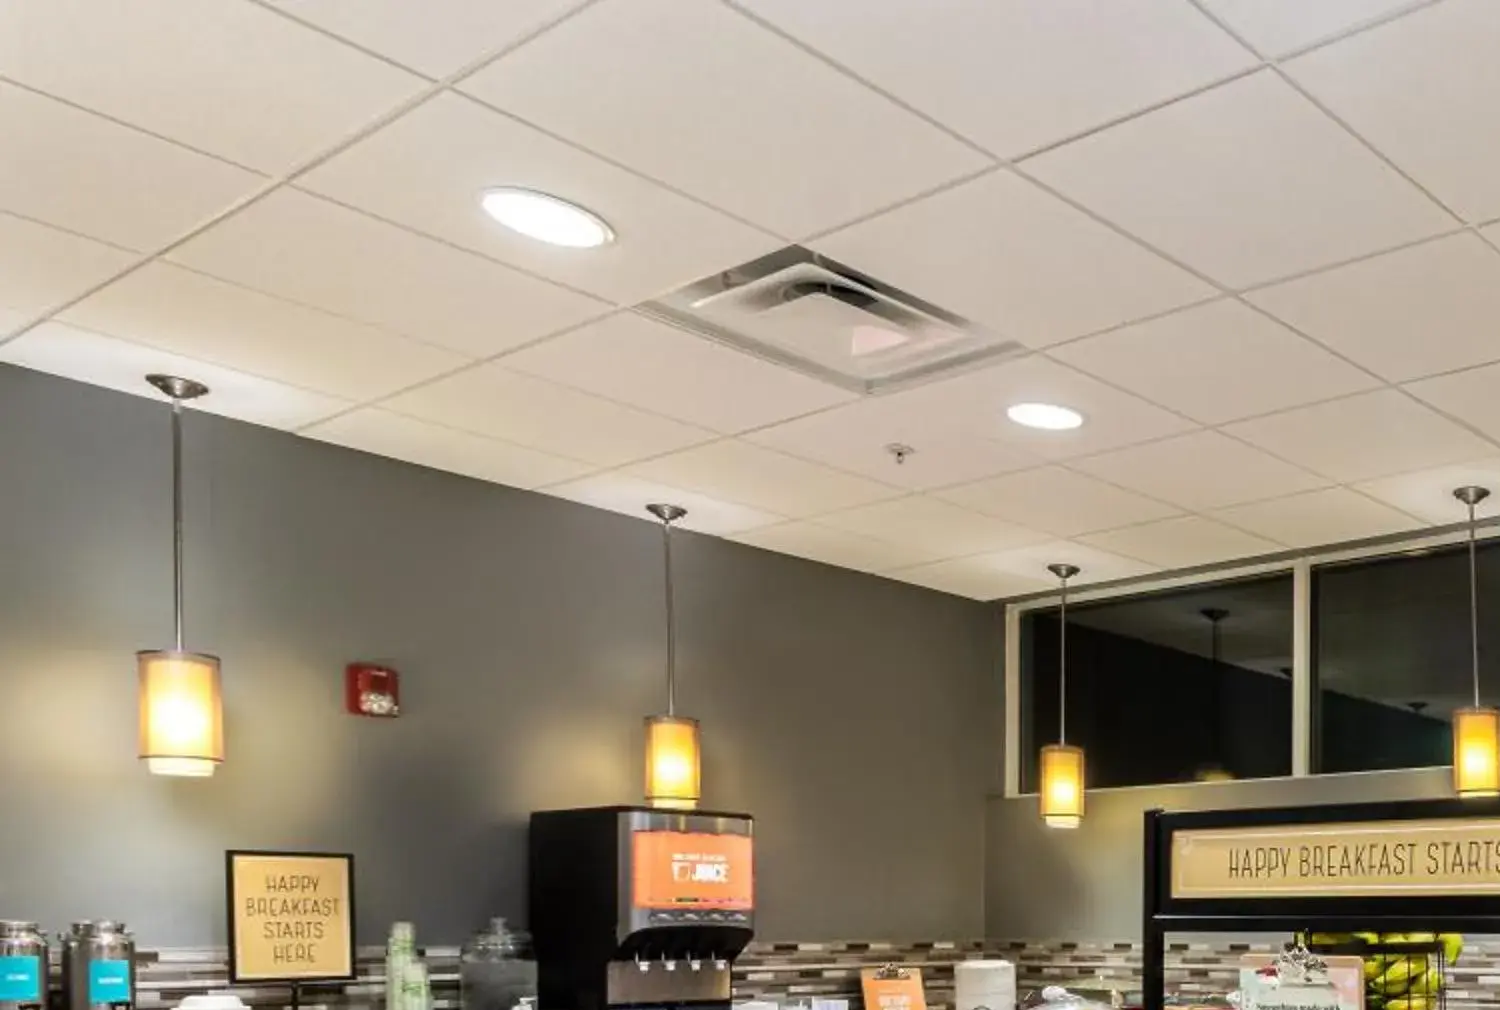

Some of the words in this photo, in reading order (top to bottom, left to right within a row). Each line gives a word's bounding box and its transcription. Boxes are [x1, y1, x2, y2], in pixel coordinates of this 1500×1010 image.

[1228, 847, 1291, 878] HAPPY
[1299, 843, 1418, 878] BREAKFAST
[265, 875, 319, 893] HAPPY
[245, 897, 341, 918] BREAKFAST
[263, 921, 325, 940] STARTS
[273, 943, 317, 964] HERE
